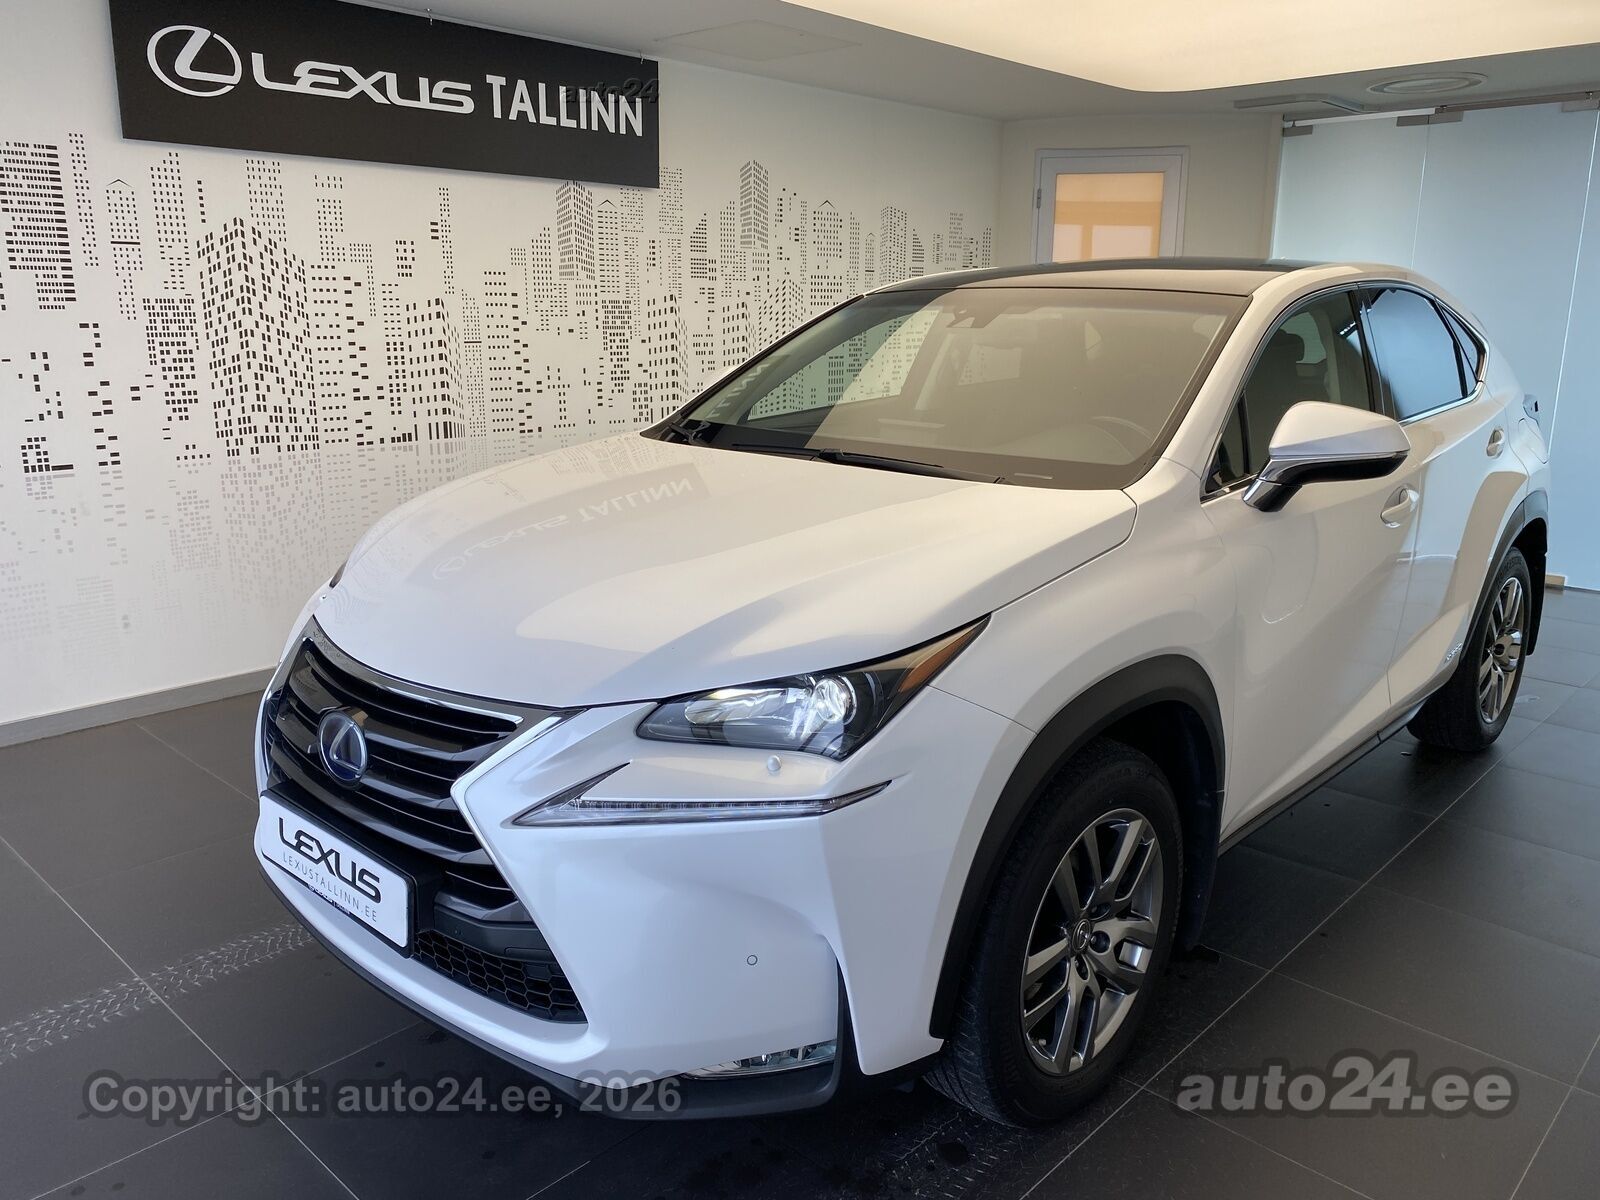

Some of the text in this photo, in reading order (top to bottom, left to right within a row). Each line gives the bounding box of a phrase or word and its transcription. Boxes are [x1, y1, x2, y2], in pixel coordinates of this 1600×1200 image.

[252, 52, 643, 138] LEXUS TALLINN
[278, 816, 382, 904] LEXUS
[282, 852, 378, 923] LEXUSTALLINN.EE
